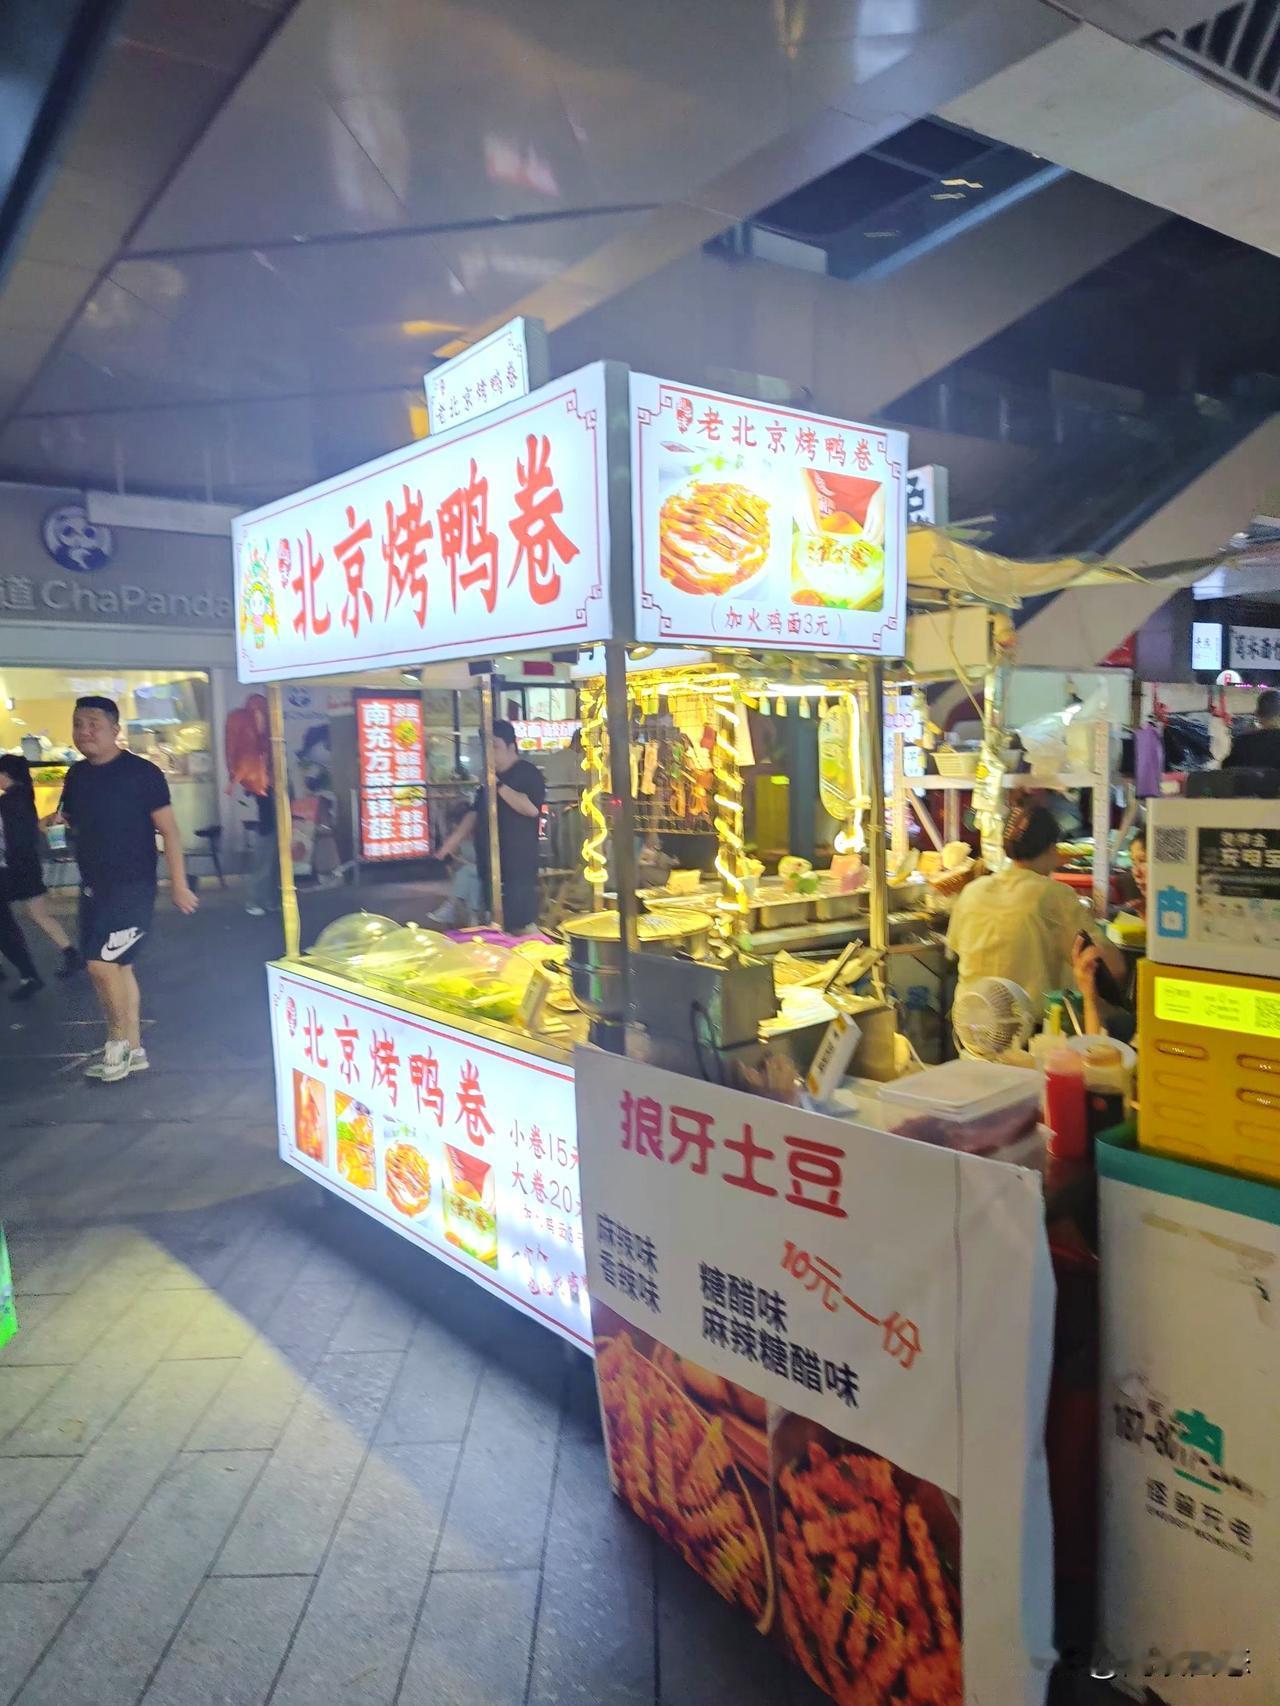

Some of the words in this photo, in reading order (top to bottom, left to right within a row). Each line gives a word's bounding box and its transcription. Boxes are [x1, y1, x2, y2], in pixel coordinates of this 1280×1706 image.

[697, 406, 873, 472] 老北京烤鸭卷
[292, 433, 581, 642] 北京烤鸭卷
[42, 579, 231, 620] ChaPanda
[303, 1006, 495, 1147] 北京烤鸭卷
[620, 1089, 848, 1218] 狼牙土豆
[699, 1261, 788, 1333] 糖醋味
[780, 1239, 922, 1370] 10元一份
[702, 1305, 860, 1409] 麻辣糖醋味
